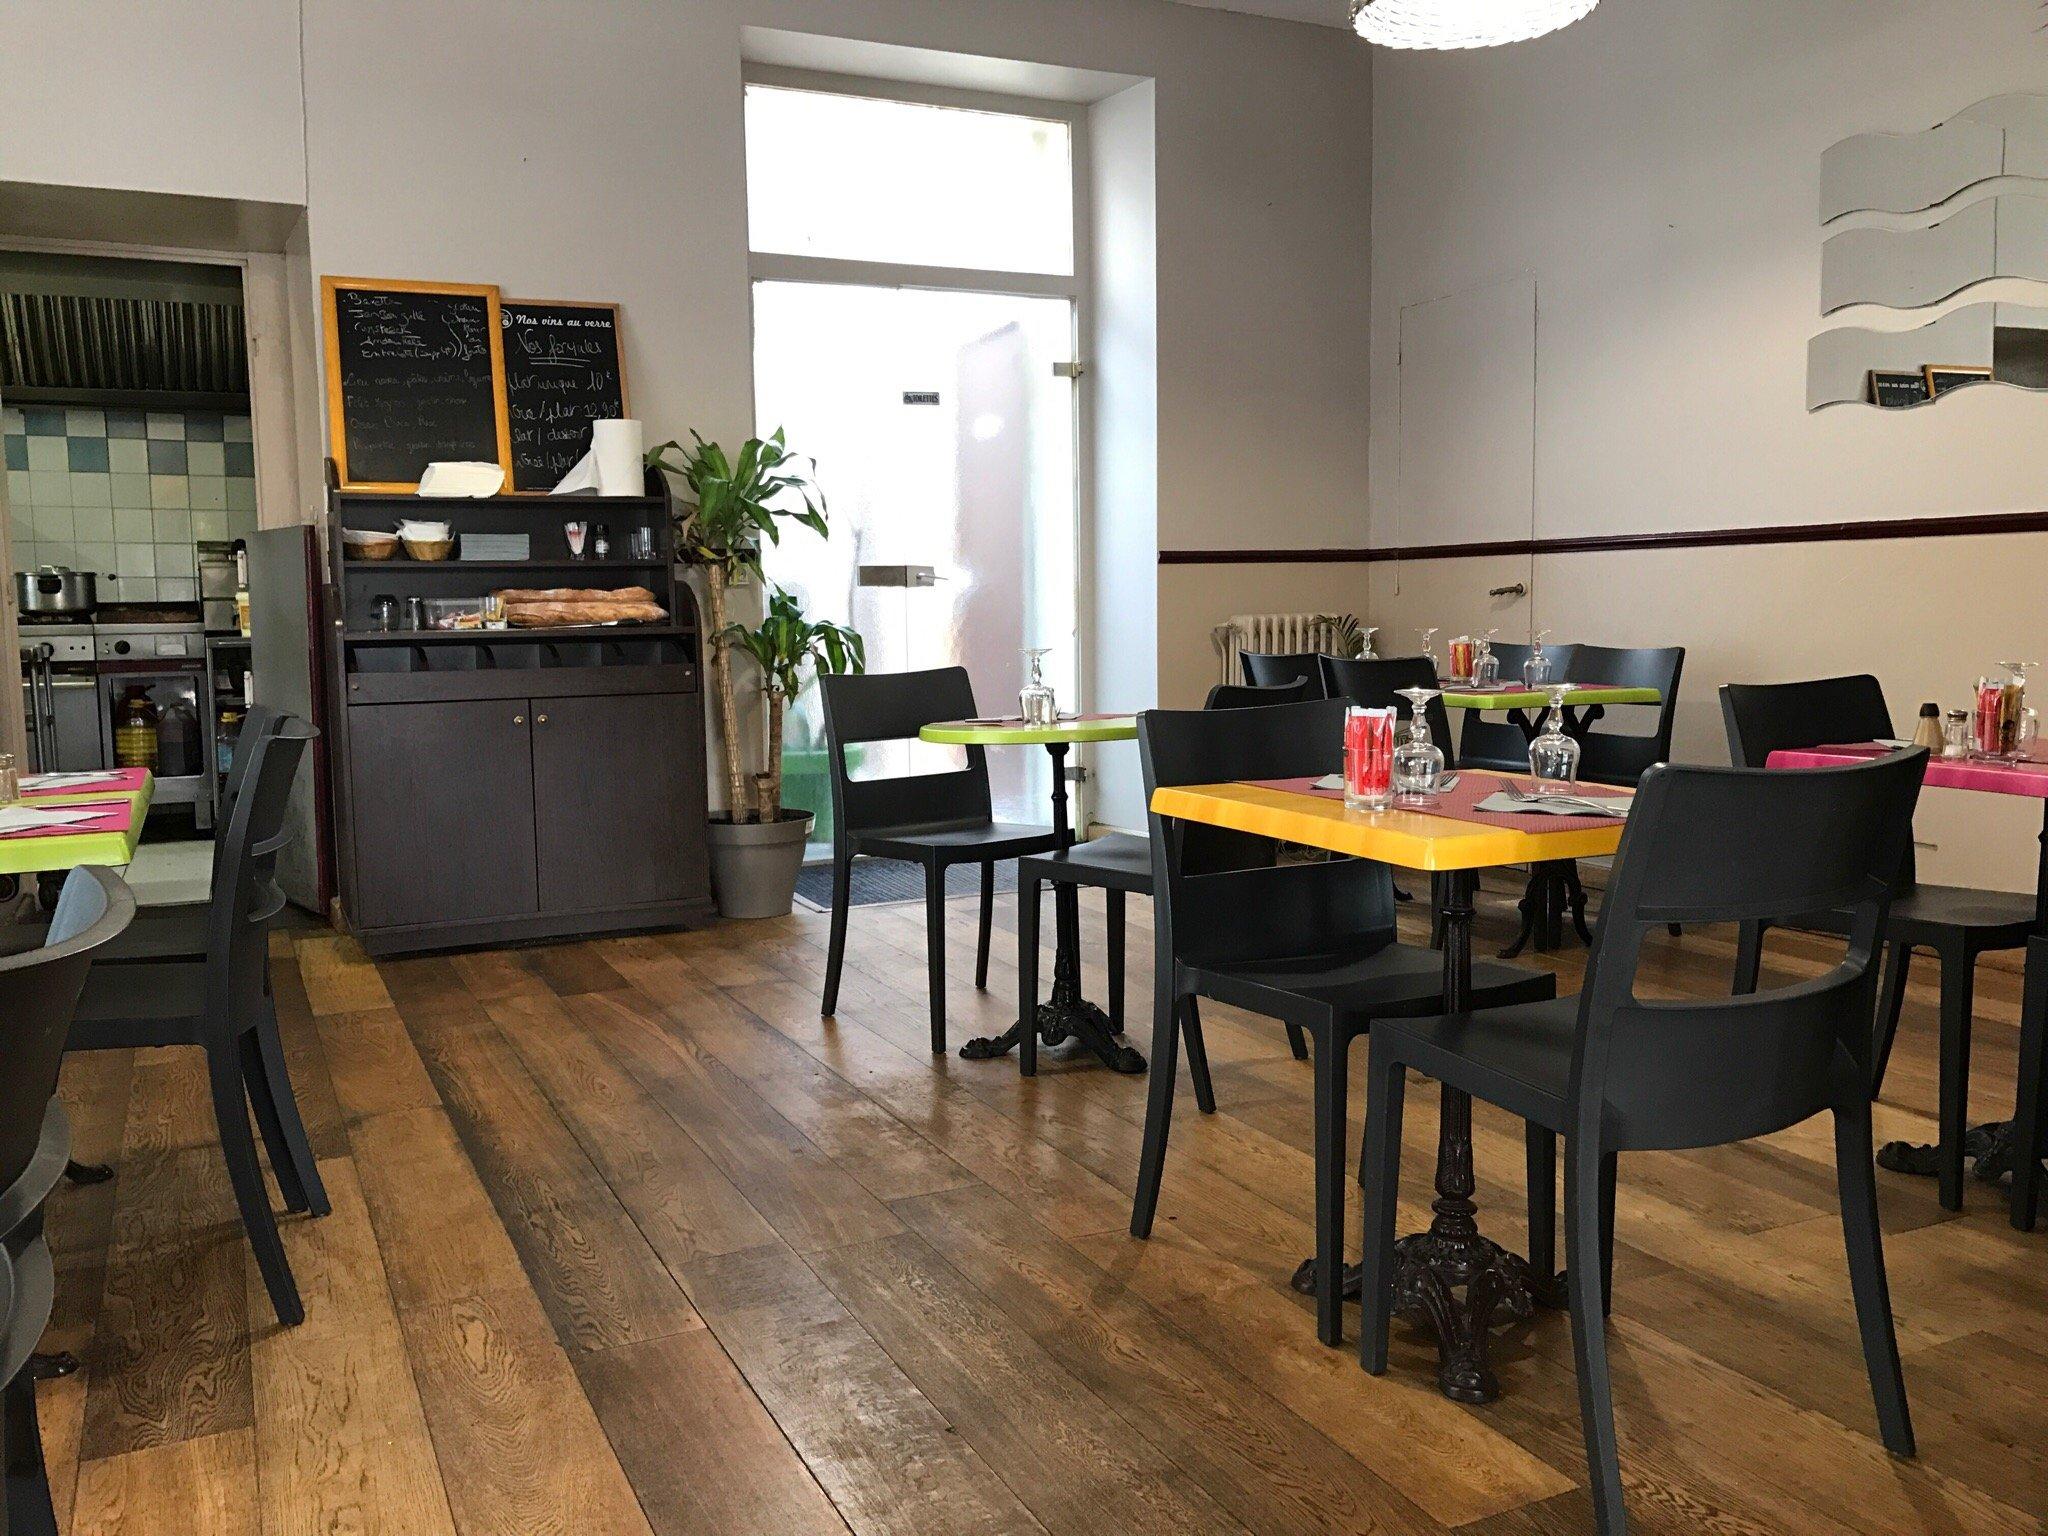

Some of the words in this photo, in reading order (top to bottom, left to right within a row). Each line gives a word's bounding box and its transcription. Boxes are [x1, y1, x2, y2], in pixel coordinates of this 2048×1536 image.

[516, 314, 538, 325] Nos
[541, 316, 563, 326] vins
[566, 318, 581, 327] au
[584, 319, 612, 328] verre
